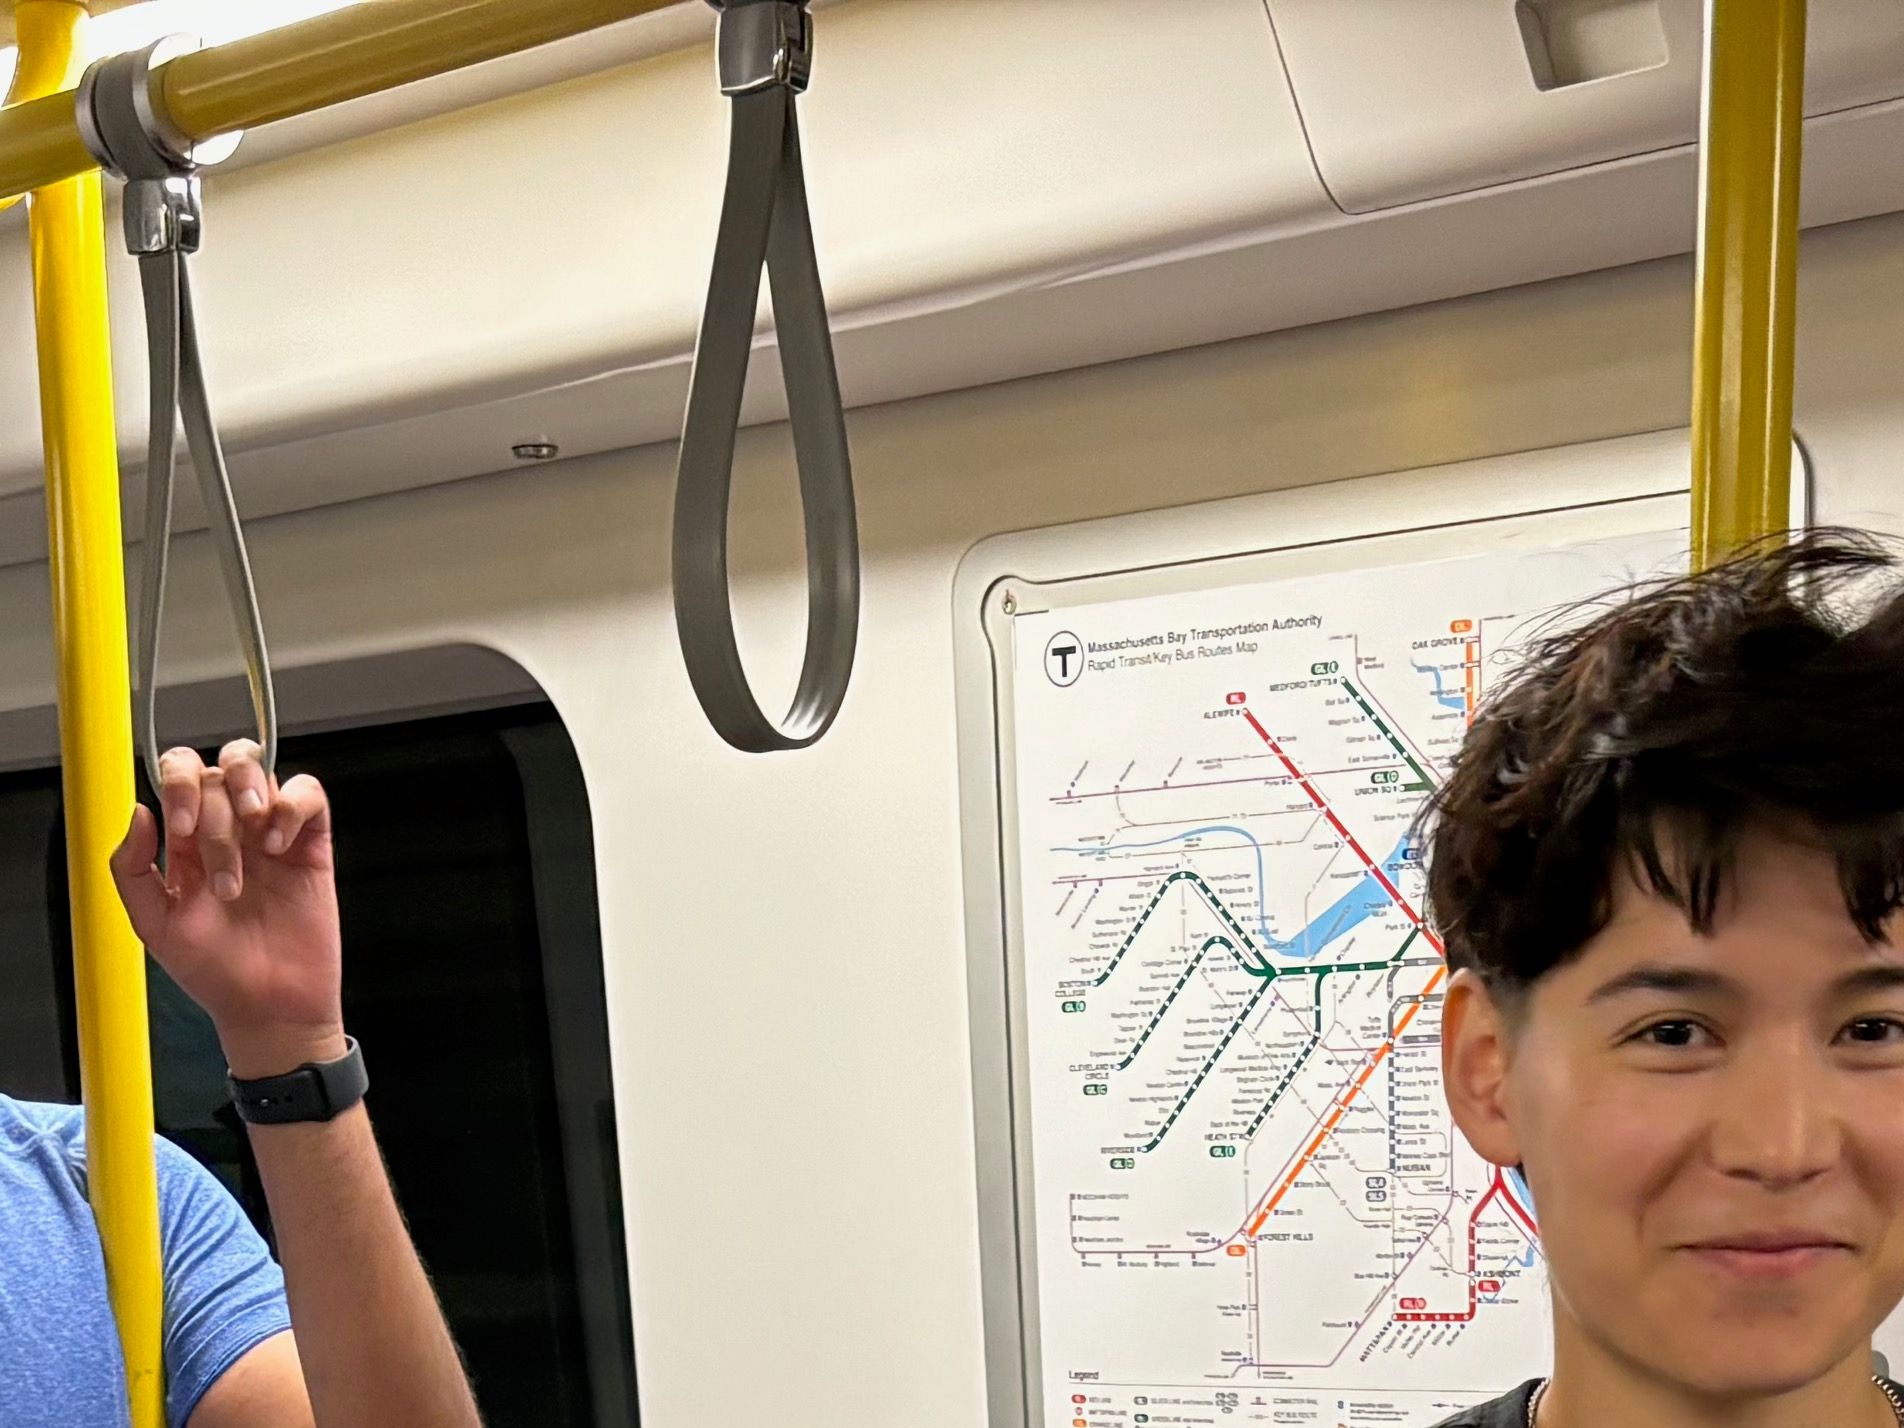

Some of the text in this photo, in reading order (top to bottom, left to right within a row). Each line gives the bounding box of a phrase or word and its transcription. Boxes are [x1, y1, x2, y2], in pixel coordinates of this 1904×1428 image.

[1088, 615, 1322, 652] Massachusetts Bay Transportation Authority
[1052, 646, 1076, 677] T
[1088, 659, 1116, 671] Rapid
[1176, 650, 1195, 661] Bus
[1198, 645, 1232, 658] Routes
[1236, 642, 1258, 653] Map
[1069, 1370, 1099, 1381] Legend
